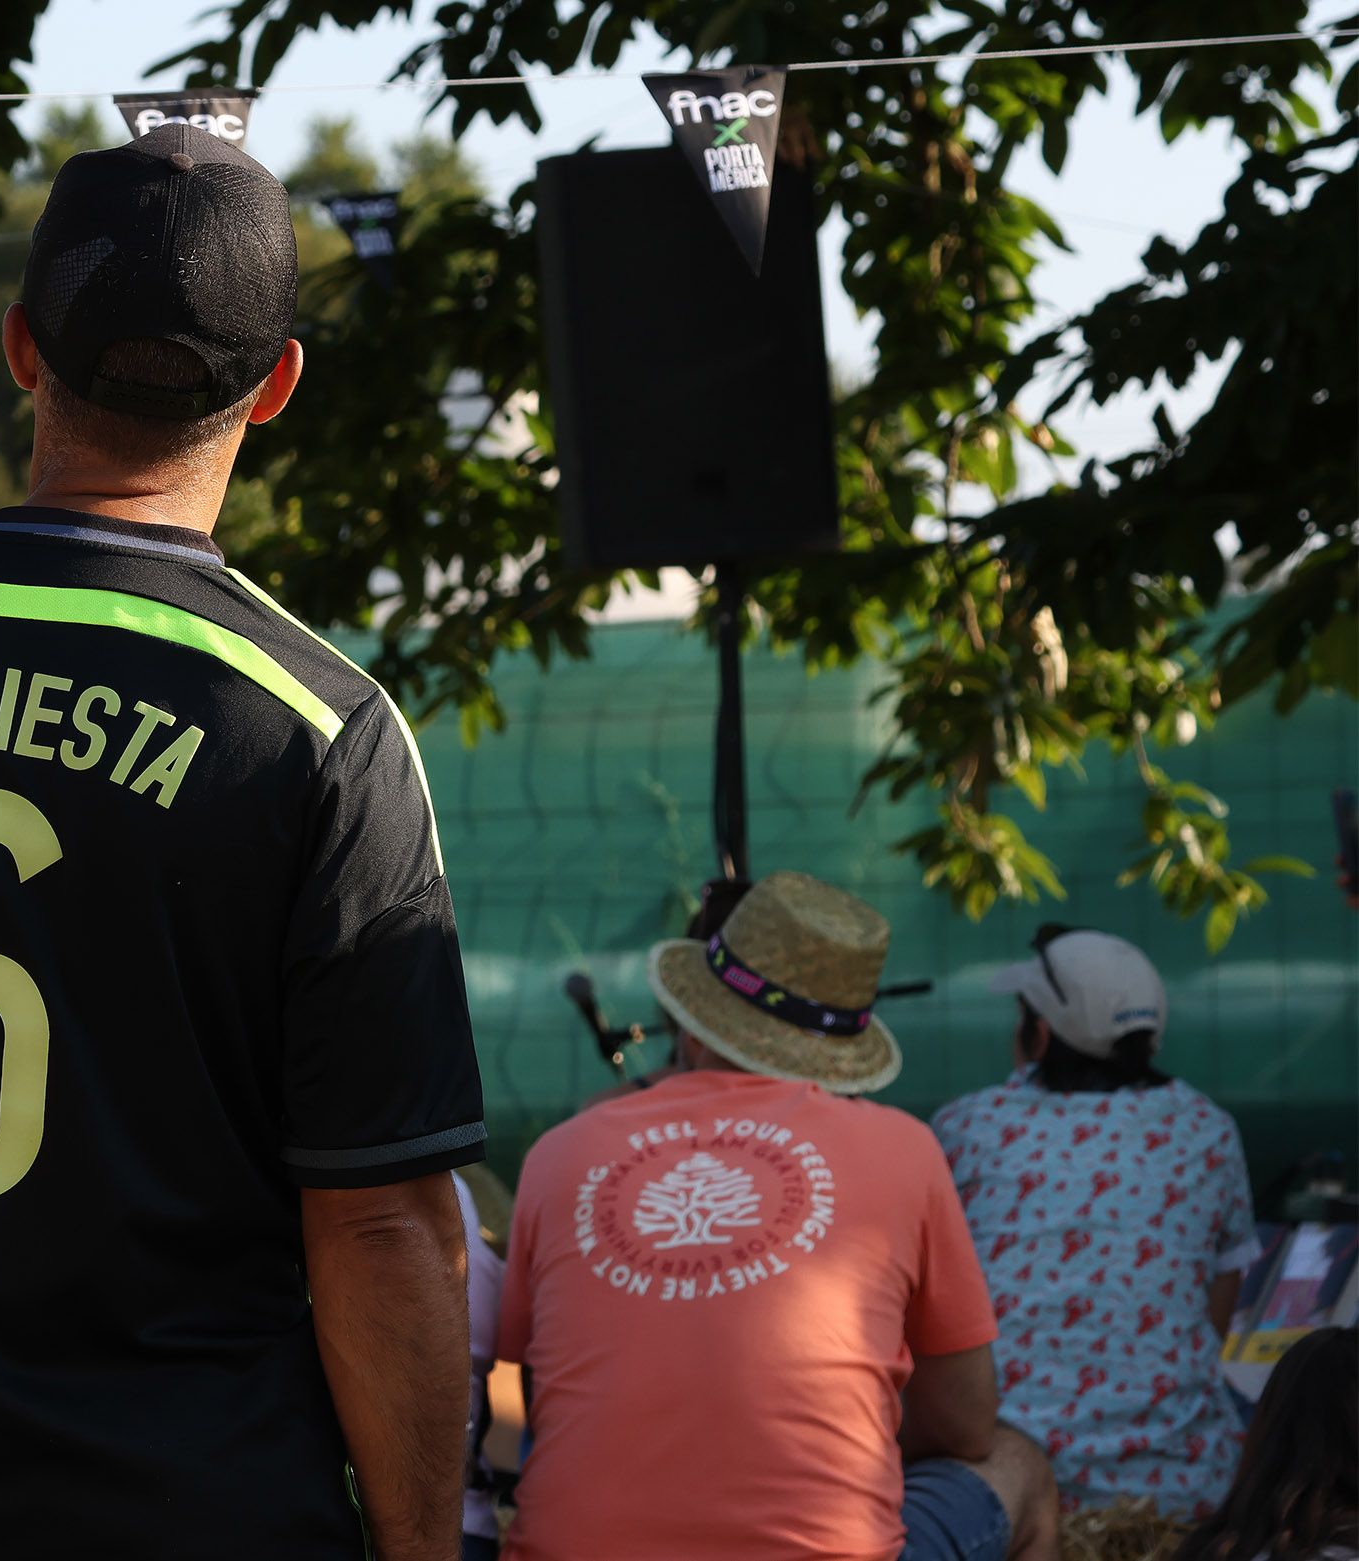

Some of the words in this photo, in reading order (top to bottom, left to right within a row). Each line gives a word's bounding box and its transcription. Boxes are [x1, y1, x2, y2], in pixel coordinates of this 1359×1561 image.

[135, 109, 244, 141] fac
[666, 90, 777, 126] fnac
[703, 143, 765, 172] PORTA
[628, 1121, 697, 1151] FEEL
[714, 1118, 792, 1147] YOUR
[592, 1256, 652, 1296] NOT
[660, 1251, 789, 1300] THEY'RE
